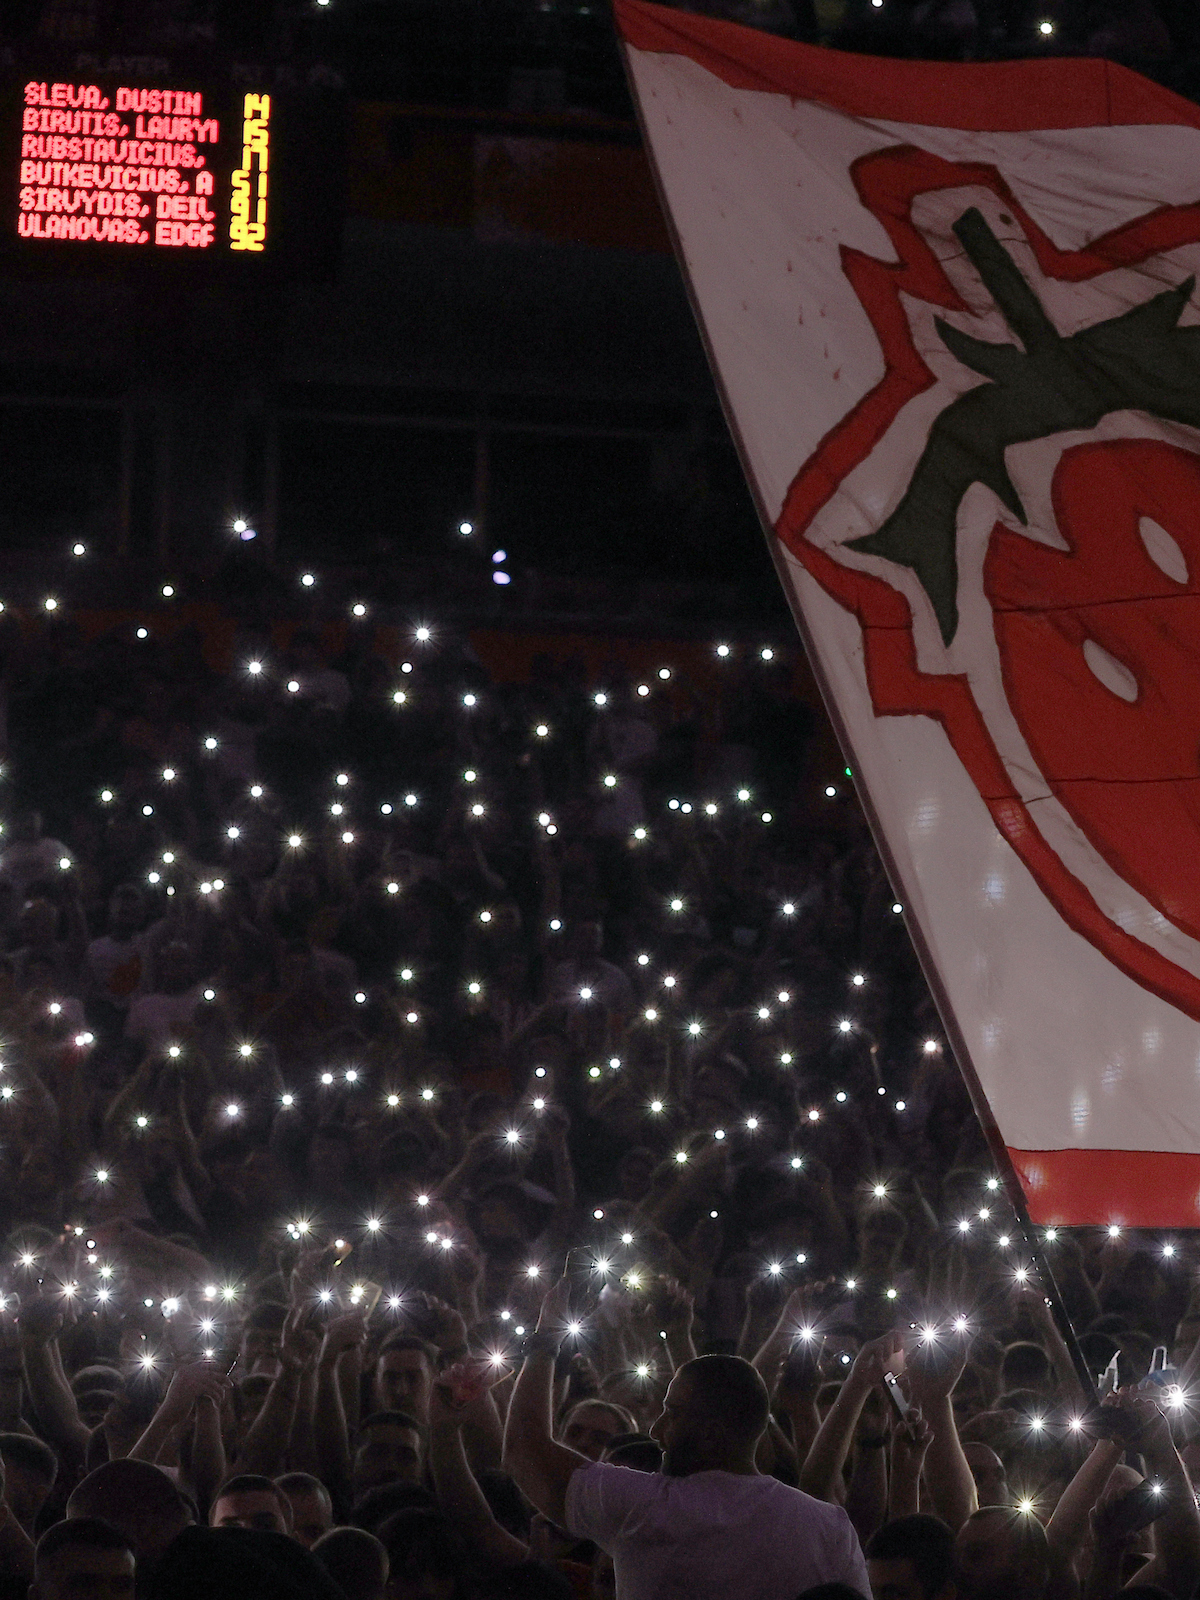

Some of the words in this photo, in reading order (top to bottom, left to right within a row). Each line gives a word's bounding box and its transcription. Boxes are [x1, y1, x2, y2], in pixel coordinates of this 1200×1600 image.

[24, 81, 109, 110] SLEVA,
[116, 87, 202, 115] DUSTIN
[22, 107, 129, 136] BIRUTIS,
[20, 160, 189, 193] BUTKEVICIUS,
[19, 186, 150, 218] SIRVYDIS,
